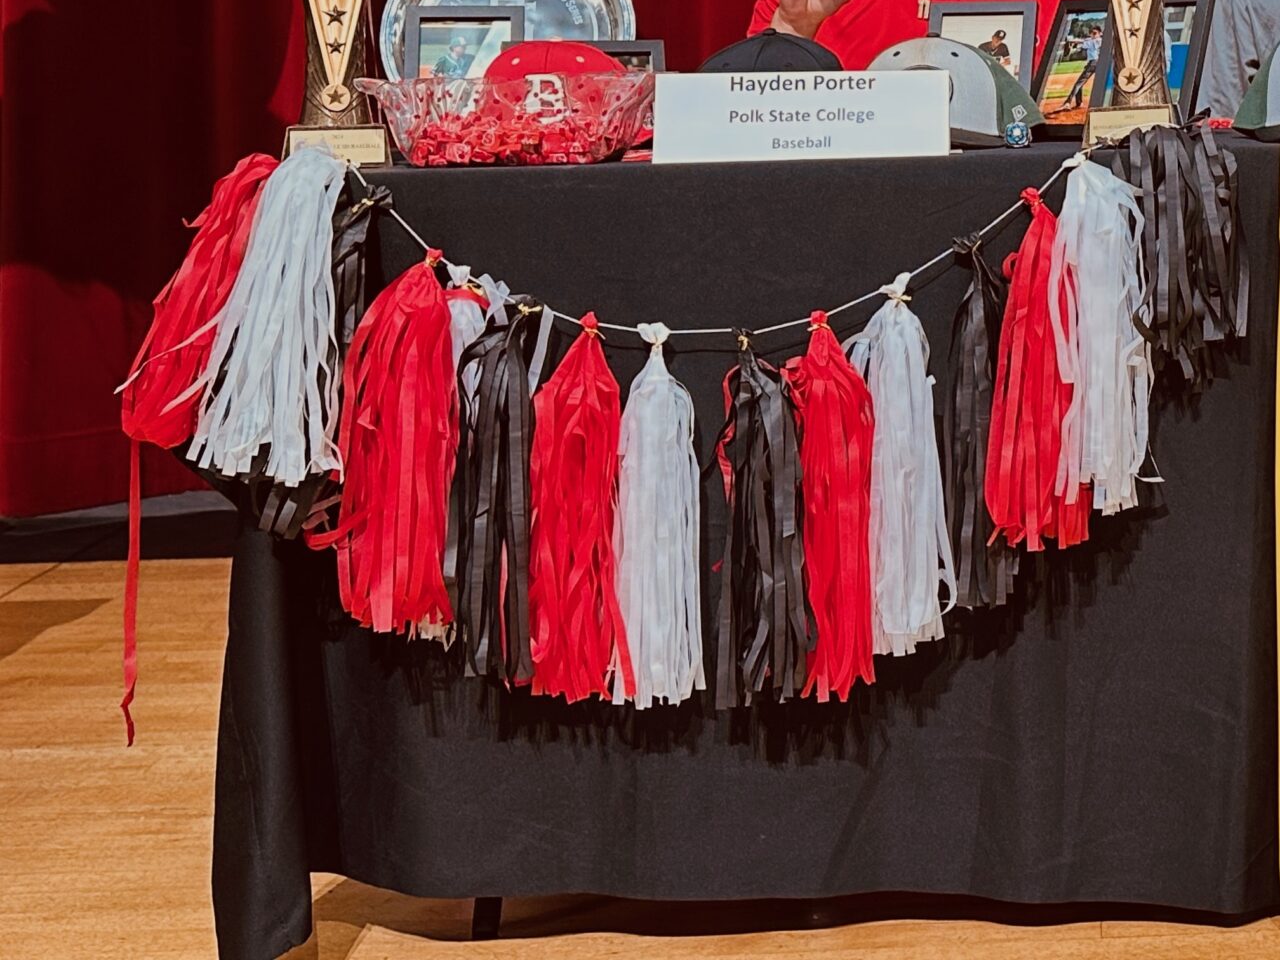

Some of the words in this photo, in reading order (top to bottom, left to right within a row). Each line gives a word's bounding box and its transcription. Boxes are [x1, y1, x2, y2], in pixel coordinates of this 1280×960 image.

[730, 75, 806, 95] Hayden
[813, 74, 876, 91] Porter
[729, 109, 764, 123] Polk
[769, 109, 810, 122] State
[816, 108, 875, 124] College
[772, 136, 832, 149] Baseball
